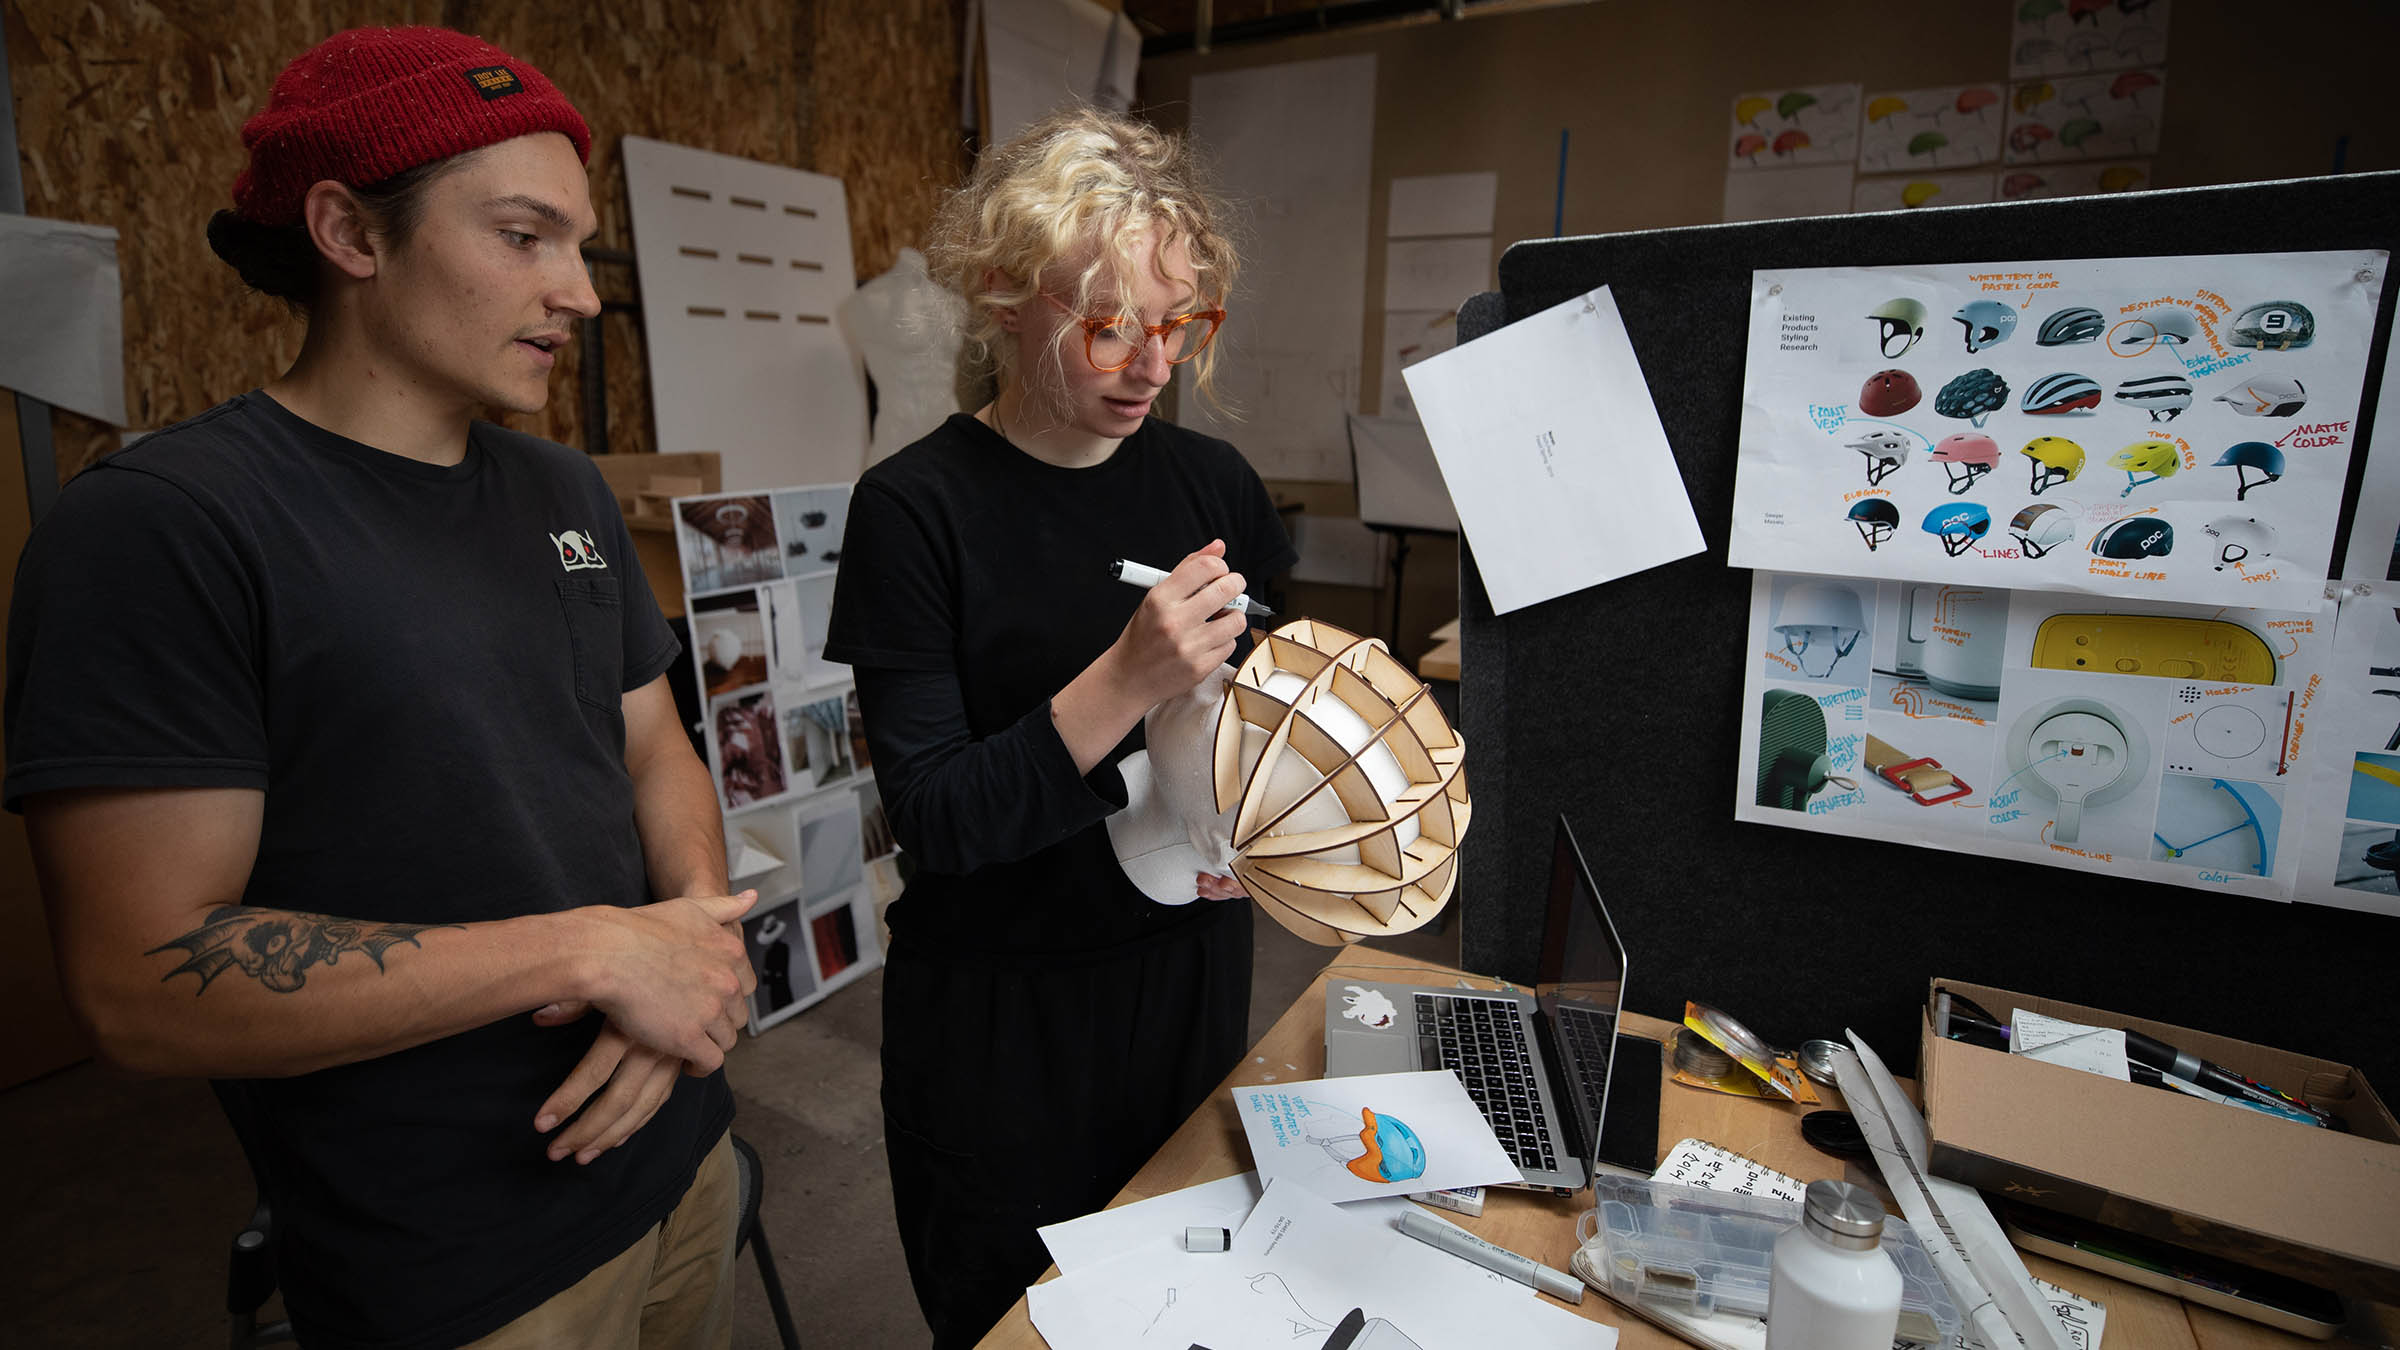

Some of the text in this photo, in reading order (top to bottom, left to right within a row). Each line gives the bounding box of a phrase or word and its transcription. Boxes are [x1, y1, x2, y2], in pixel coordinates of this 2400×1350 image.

[2038, 272, 2053, 280] ON
[1981, 280, 2060, 291] PASTEL COLOR
[1782, 314, 1816, 323] Existing
[2265, 314, 2286, 329] 9
[1781, 324, 1819, 332] Products
[1781, 334, 1809, 343] Styling
[1808, 404, 1848, 419] FRONT
[1813, 416, 1847, 430] VENT
[2296, 421, 2350, 436] MATTE
[2293, 435, 2343, 449] COLOR
[1983, 549, 2020, 560] LINES
[2205, 686, 2239, 697] HOLES
